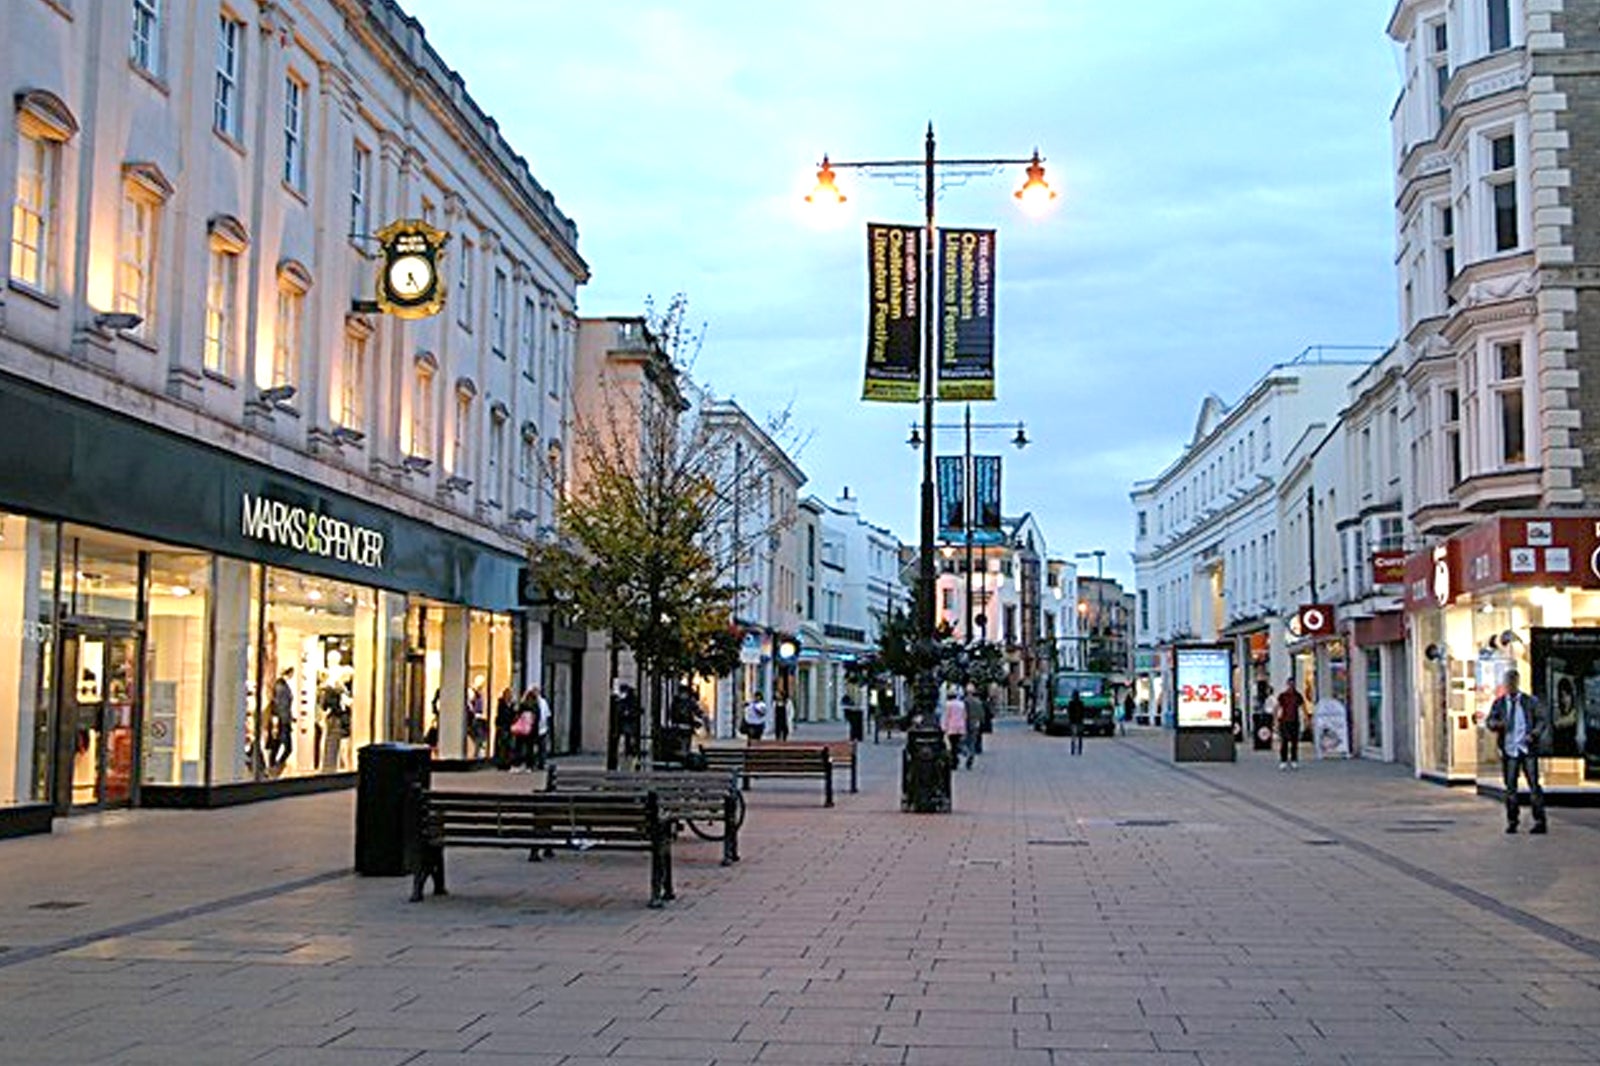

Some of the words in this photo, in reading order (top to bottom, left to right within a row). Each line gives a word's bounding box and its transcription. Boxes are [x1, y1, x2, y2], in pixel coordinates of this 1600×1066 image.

[874, 229, 888, 300] Literature
[889, 229, 904, 319] Cheltenham
[944, 233, 960, 303] Literature
[960, 233, 977, 320] Cheltenham
[873, 302, 889, 363] Festival
[944, 305, 960, 364] Festival
